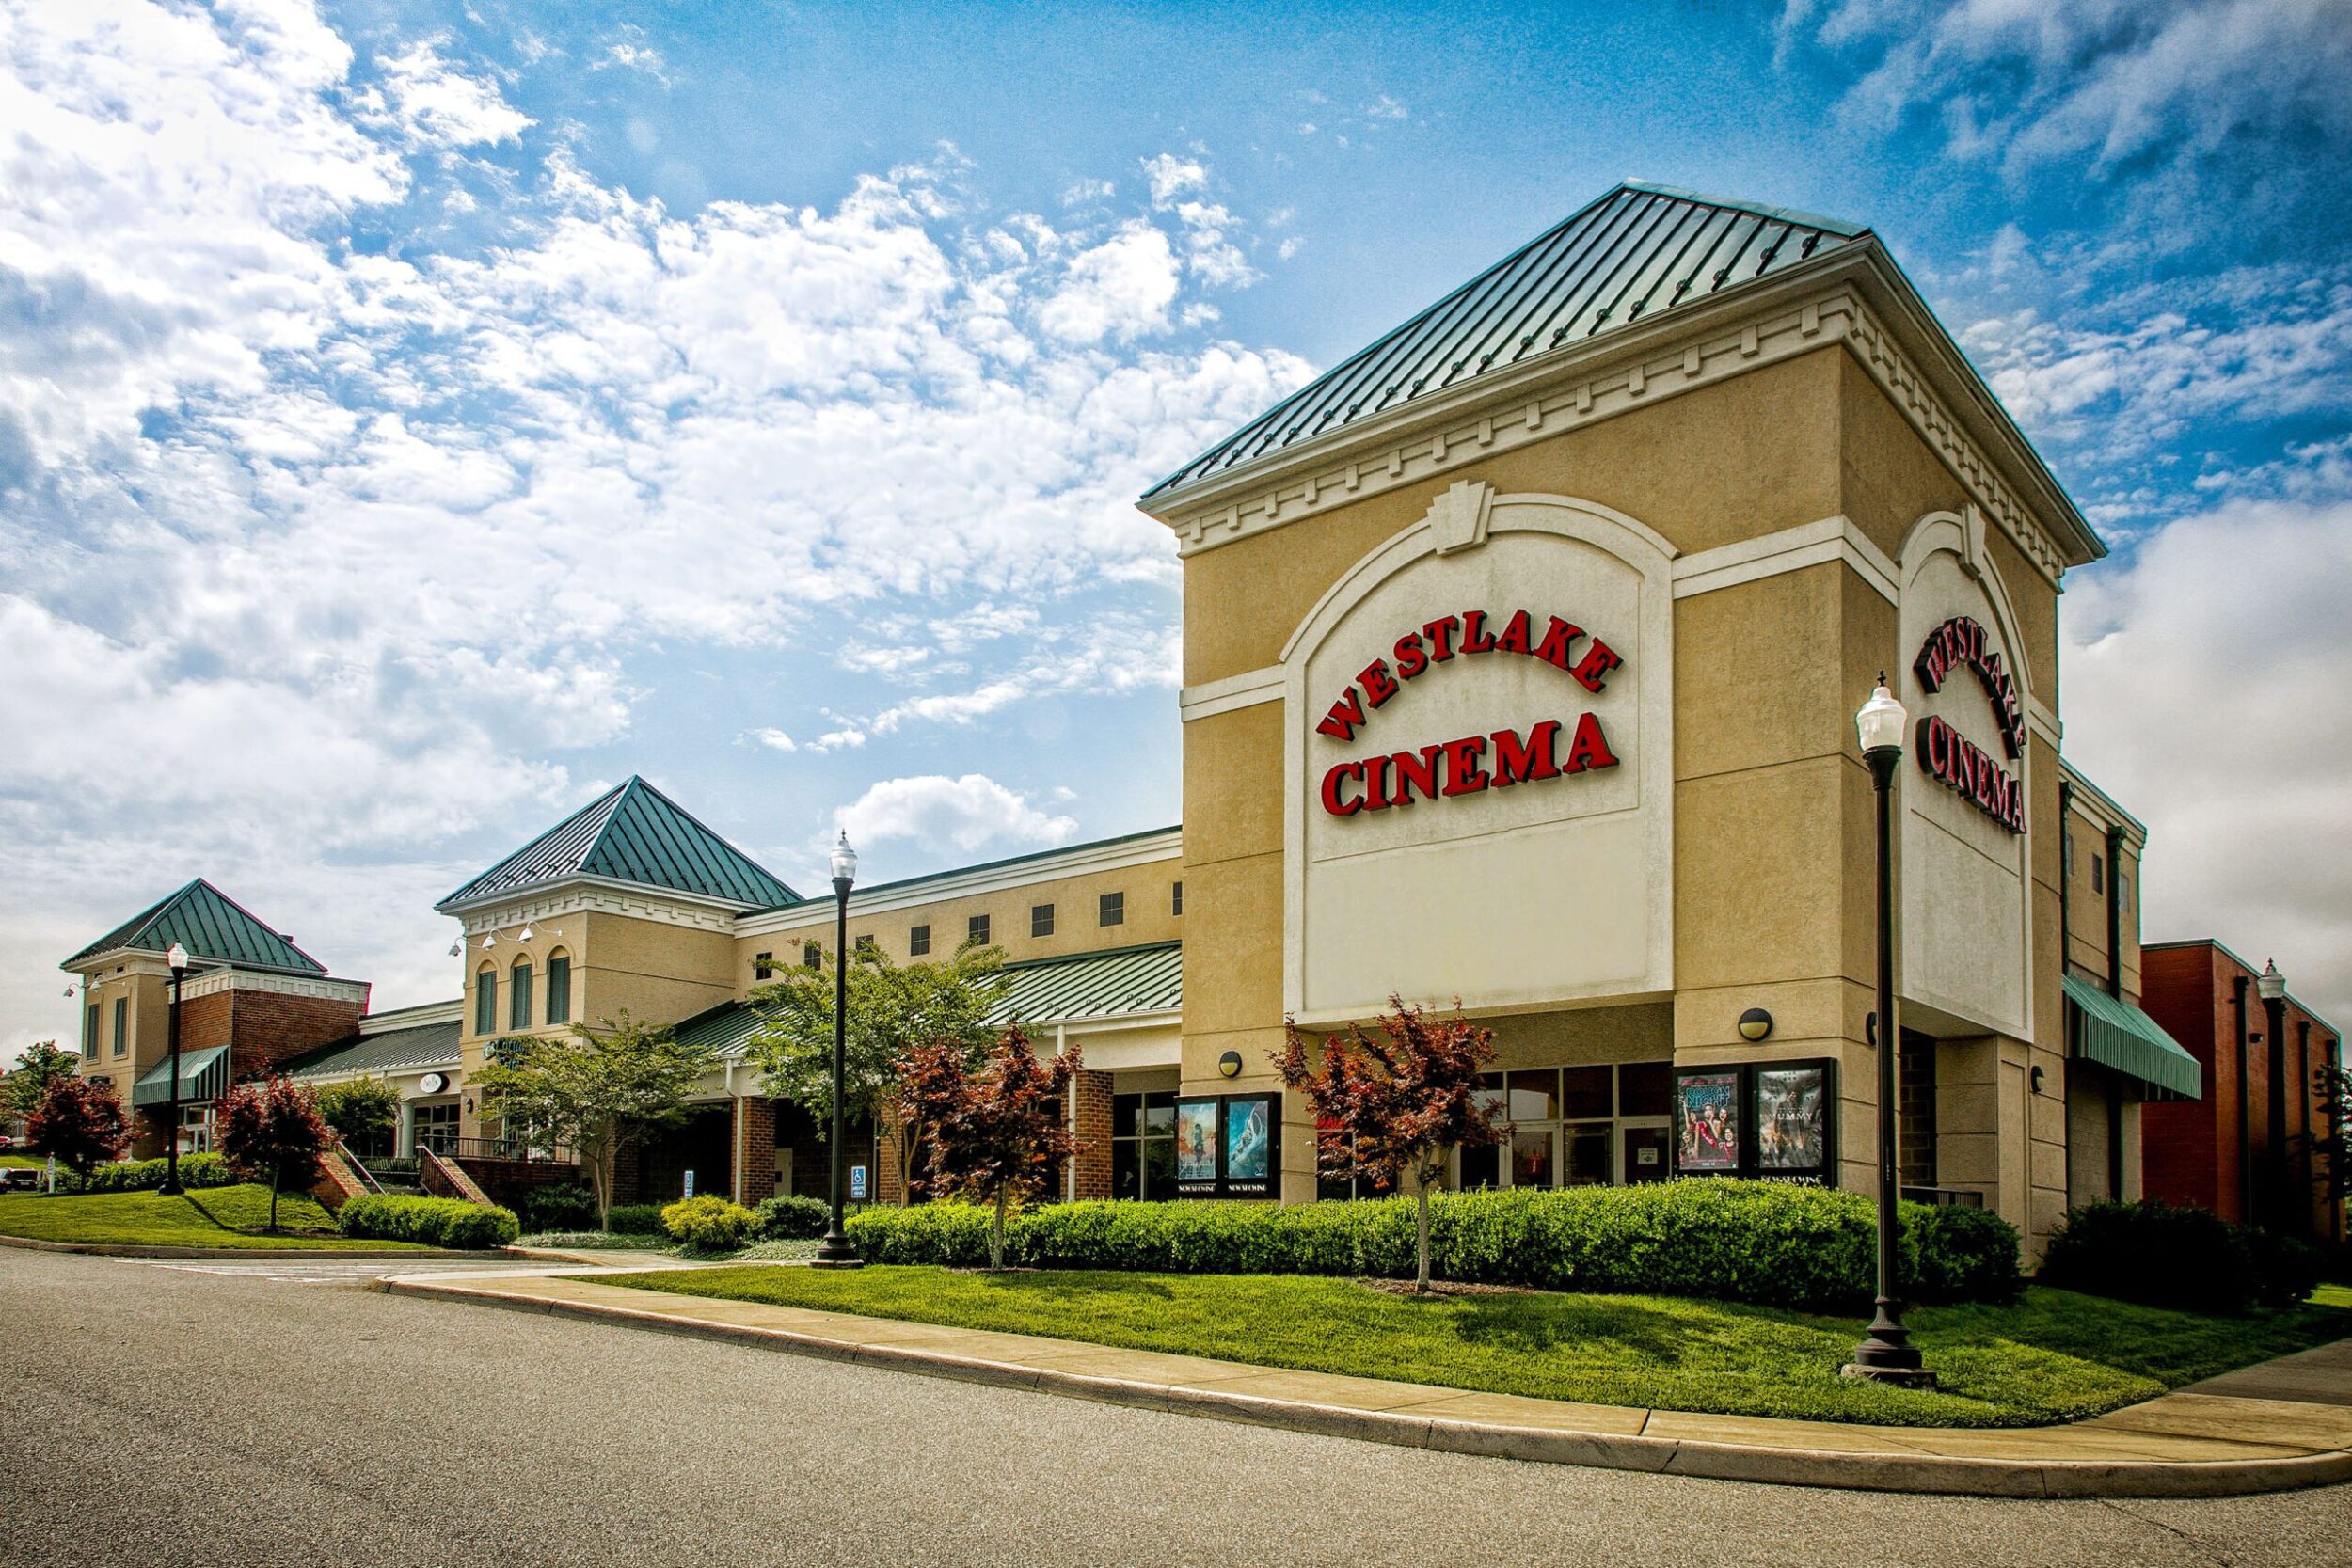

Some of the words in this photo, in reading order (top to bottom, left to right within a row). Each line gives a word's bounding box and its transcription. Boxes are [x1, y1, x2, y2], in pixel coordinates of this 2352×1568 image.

[1315, 609, 1624, 743] WESTLAKE
[1913, 615, 2027, 760] WESTLAKE
[1320, 711, 1620, 817] CINEMA
[1915, 714, 2027, 835] CINEMA
[1686, 1085, 1731, 1101] ROUGH
[1687, 1094, 1729, 1108] NIGHT
[1769, 1112, 1813, 1121] MUMMY
